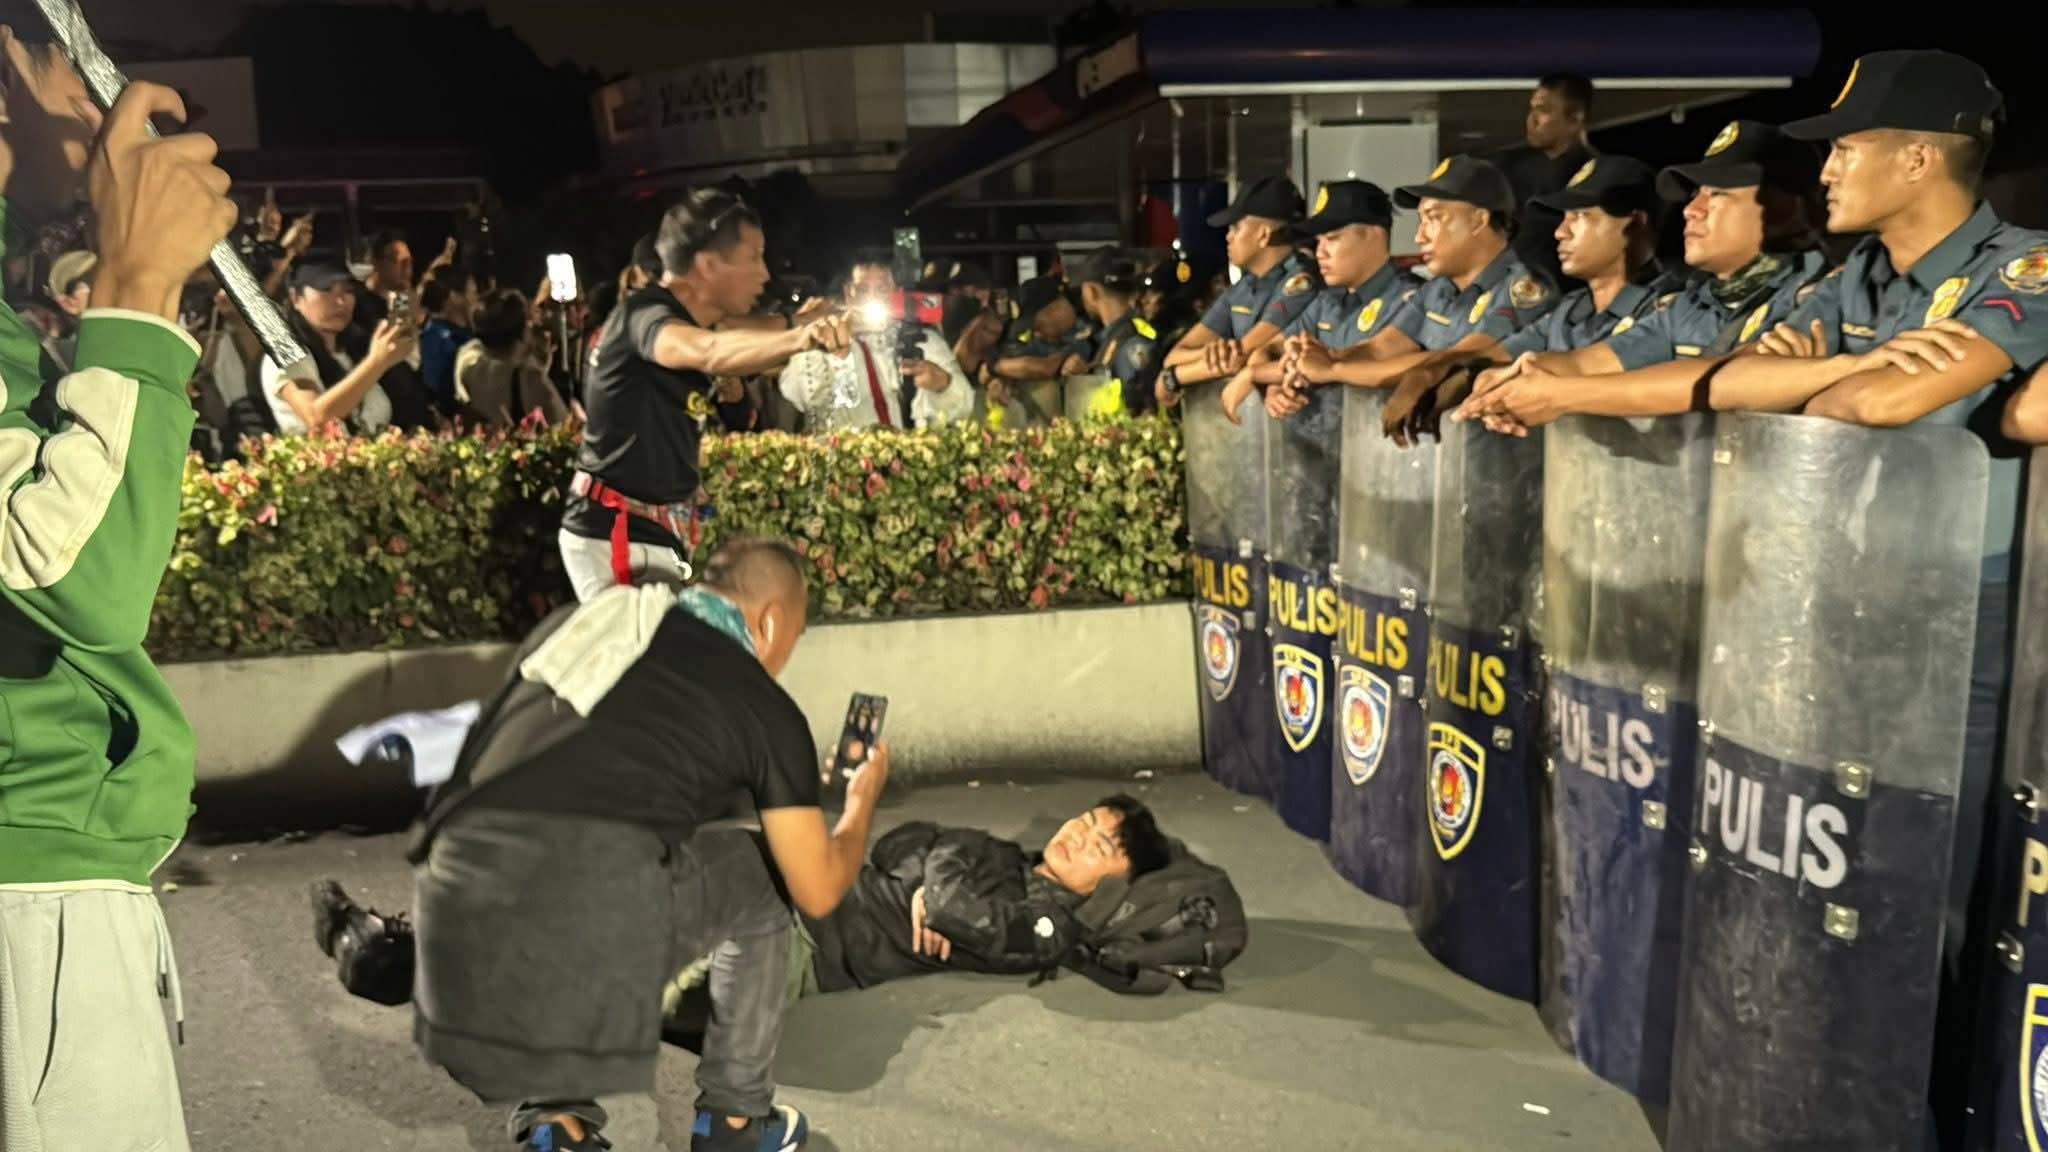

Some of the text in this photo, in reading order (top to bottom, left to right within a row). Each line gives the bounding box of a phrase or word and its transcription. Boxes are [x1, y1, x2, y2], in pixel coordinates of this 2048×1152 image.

[1268, 574, 1338, 636] PULIS
[1550, 687, 1655, 789] PULIS
[1701, 757, 1849, 889] PULIS
